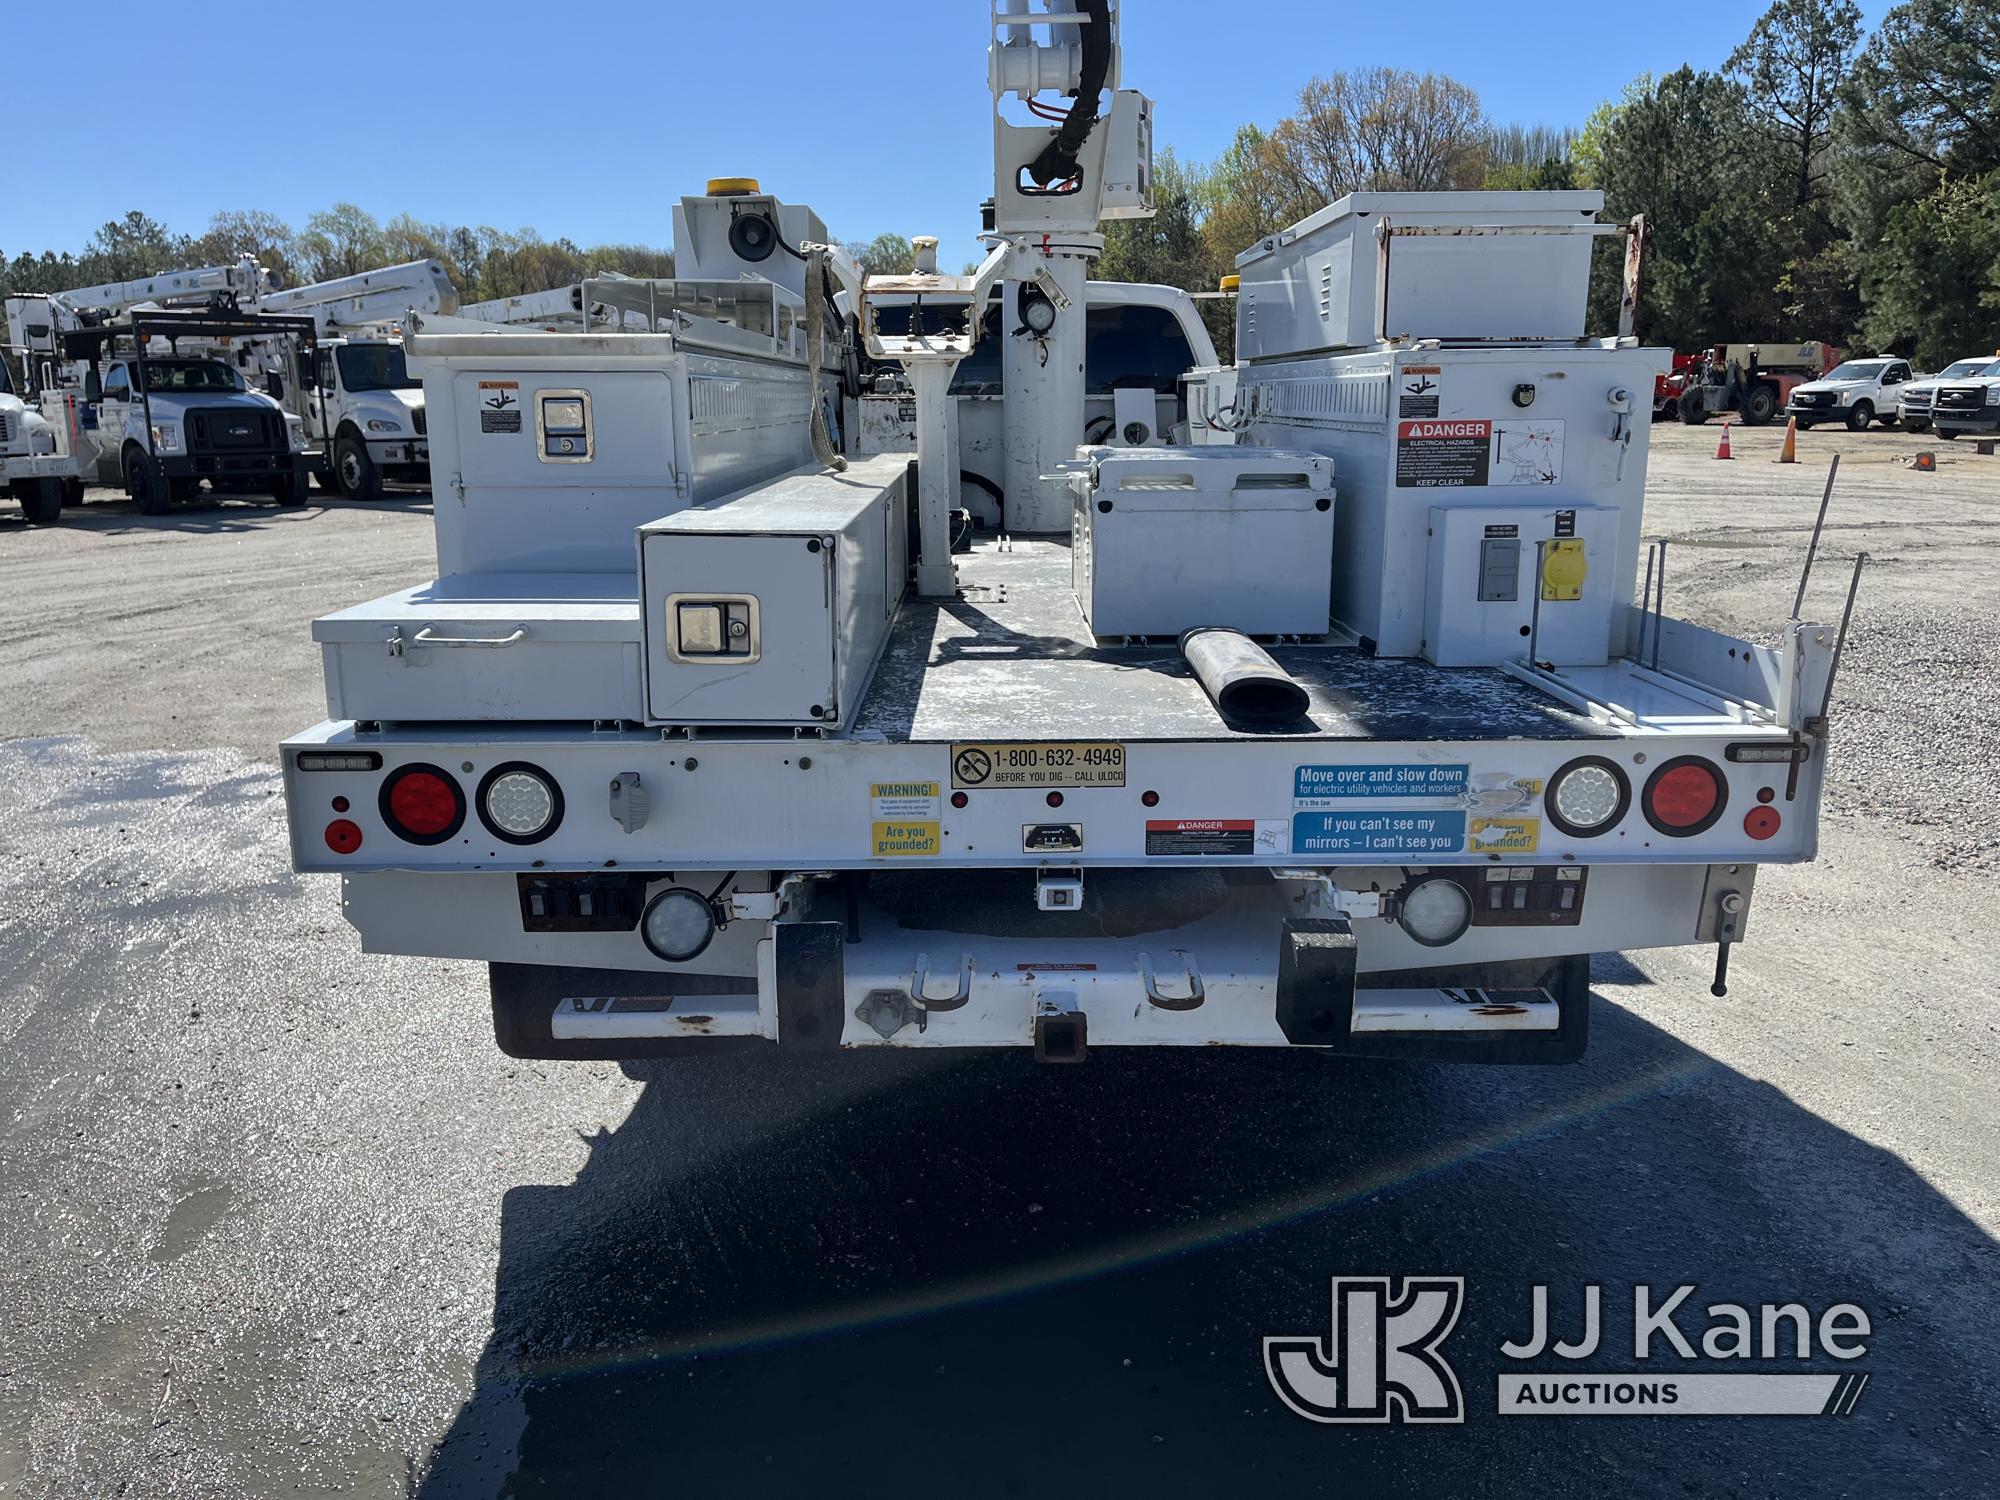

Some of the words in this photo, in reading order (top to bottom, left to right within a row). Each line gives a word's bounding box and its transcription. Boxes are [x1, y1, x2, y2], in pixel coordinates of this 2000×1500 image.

[1424, 424, 1485, 436] DANGER
[994, 749, 1121, 766] 1-800-632-4949
[996, 772, 1025, 782] BEFORE
[1030, 772, 1045, 782] YOU
[1050, 772, 1062, 781] DIG
[1075, 771, 1094, 781] CALL
[1098, 771, 1123, 781] ULOCO
[1301, 768, 1333, 782] Move
[1338, 770, 1364, 782] over
[1369, 768, 1393, 782] and
[1397, 768, 1426, 781] slow
[1429, 767, 1462, 781] down
[878, 784, 932, 796] WARNING!
[1300, 784, 1311, 794] for
[1314, 783, 1344, 793] electric
[1348, 783, 1370, 795] utility
[1373, 783, 1407, 793] vehicles
[1410, 783, 1426, 792] and
[1428, 783, 1461, 792] workers
[1324, 818, 1332, 830] If
[1336, 820, 1356, 832] you
[1360, 817, 1389, 830] can't
[1393, 819, 1413, 829] see
[1418, 819, 1435, 832] my
[886, 826, 904, 837] Are
[907, 828, 925, 839] you
[879, 838, 934, 852] grounded?
[1306, 836, 1350, 848] mirrors
[1374, 835, 1403, 848] can't
[1407, 837, 1427, 848] see
[1430, 837, 1451, 849] you
